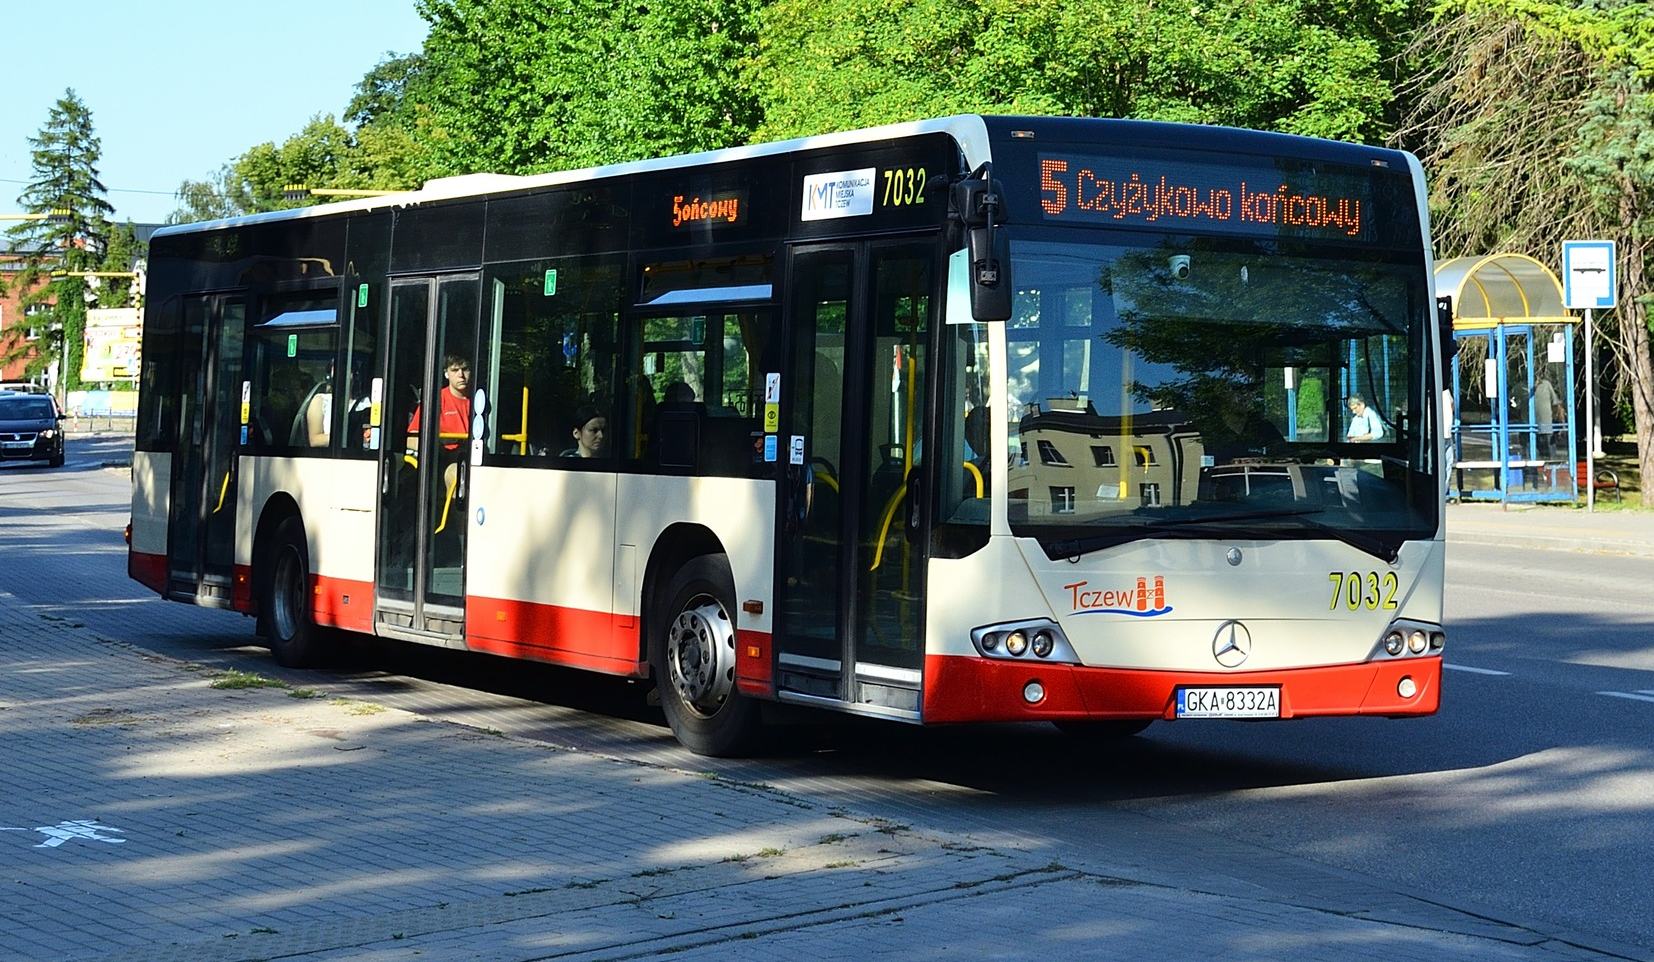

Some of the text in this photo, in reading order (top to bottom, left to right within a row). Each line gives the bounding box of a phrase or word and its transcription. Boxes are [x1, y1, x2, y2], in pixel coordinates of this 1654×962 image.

[808, 182, 836, 211] KMT
[882, 167, 926, 207] 7032
[1041, 159, 1361, 236] 5 Czyżykowo końcowy
[1064, 580, 1134, 610] Tczew
[1328, 571, 1399, 611] 7032
[1187, 691, 1276, 711] GKA 8332A
